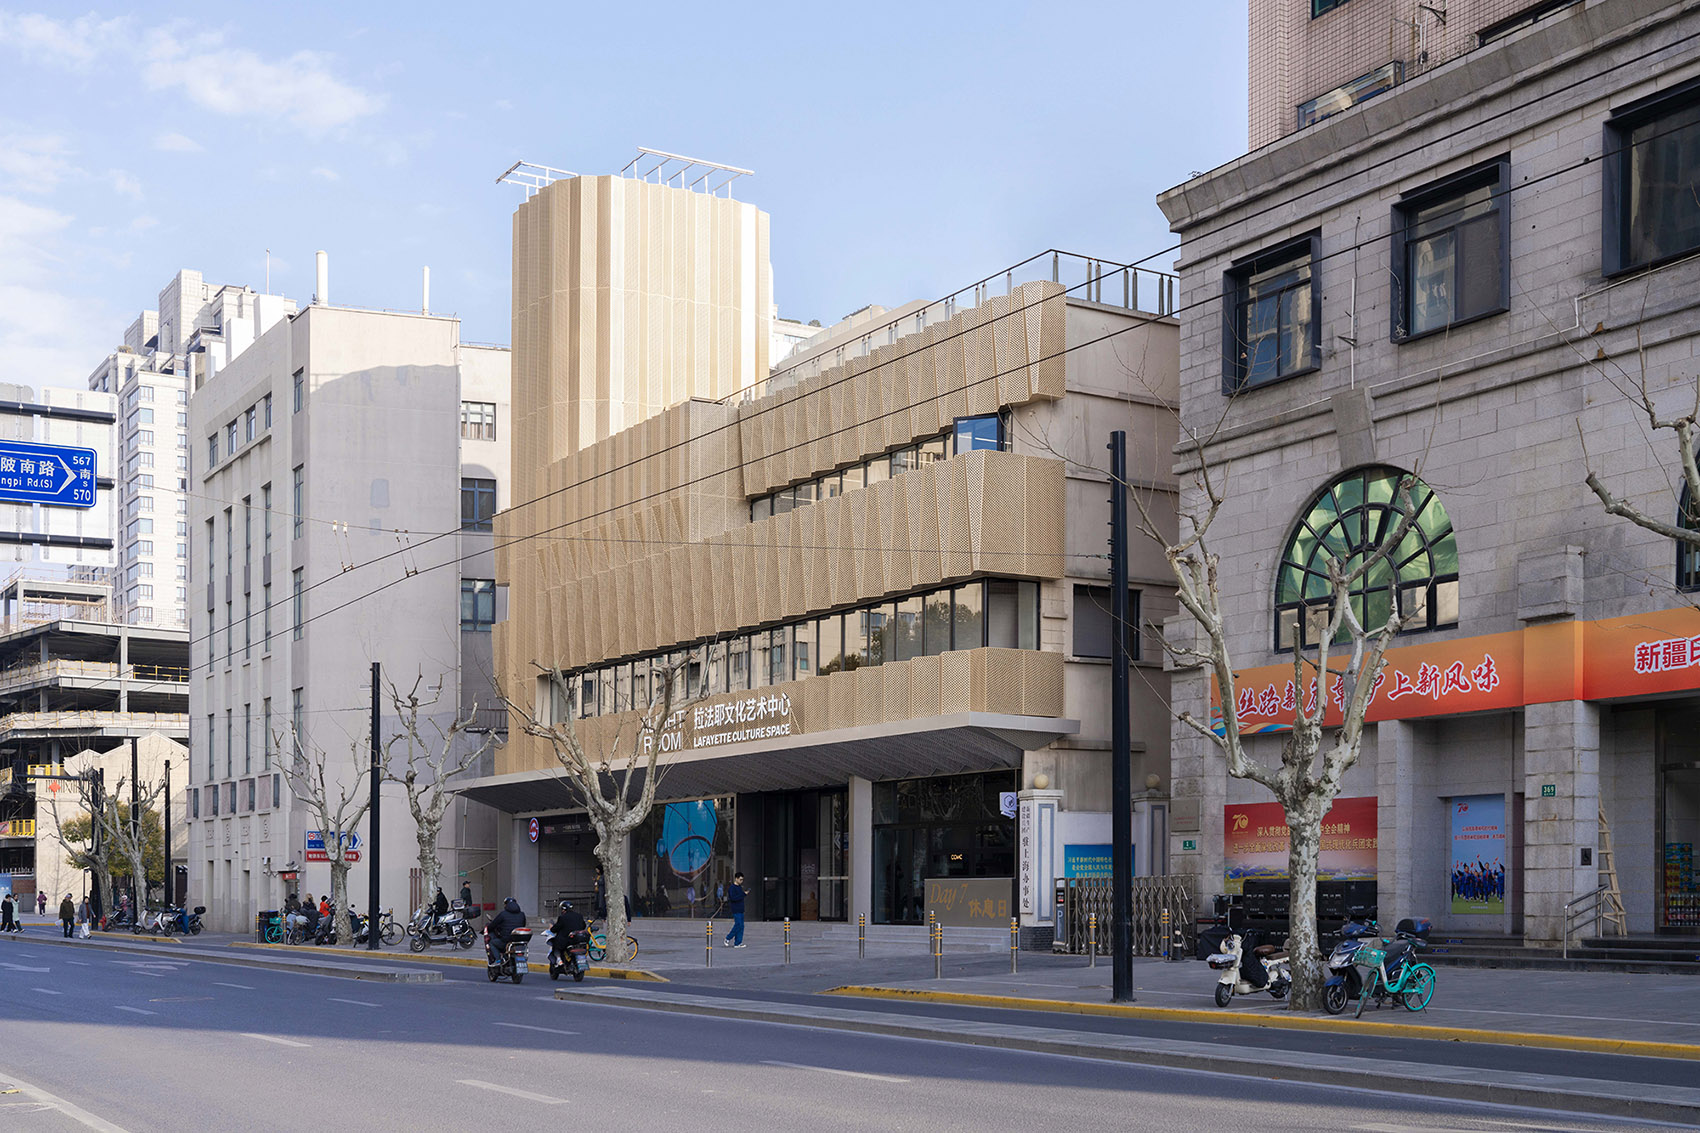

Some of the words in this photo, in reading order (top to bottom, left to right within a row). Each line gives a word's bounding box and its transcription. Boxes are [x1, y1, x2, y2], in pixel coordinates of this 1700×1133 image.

[0, 457, 55, 477] 陂南路
[72, 455, 91, 466] 567
[1, 476, 22, 488] ngpi
[27, 477, 53, 489] Rd.(S)
[79, 468, 91, 480] 南
[73, 489, 91, 501] 570
[693, 692, 791, 730] 拉法耶文化艺术中心
[643, 731, 682, 754] ROM
[693, 732, 732, 748] LAFAYETTE
[732, 727, 765, 741] CULTURE
[766, 723, 791, 737] SPACE
[929, 883, 957, 911] Day
[960, 883, 968, 904] 7
[968, 897, 1007, 919] 休息日
